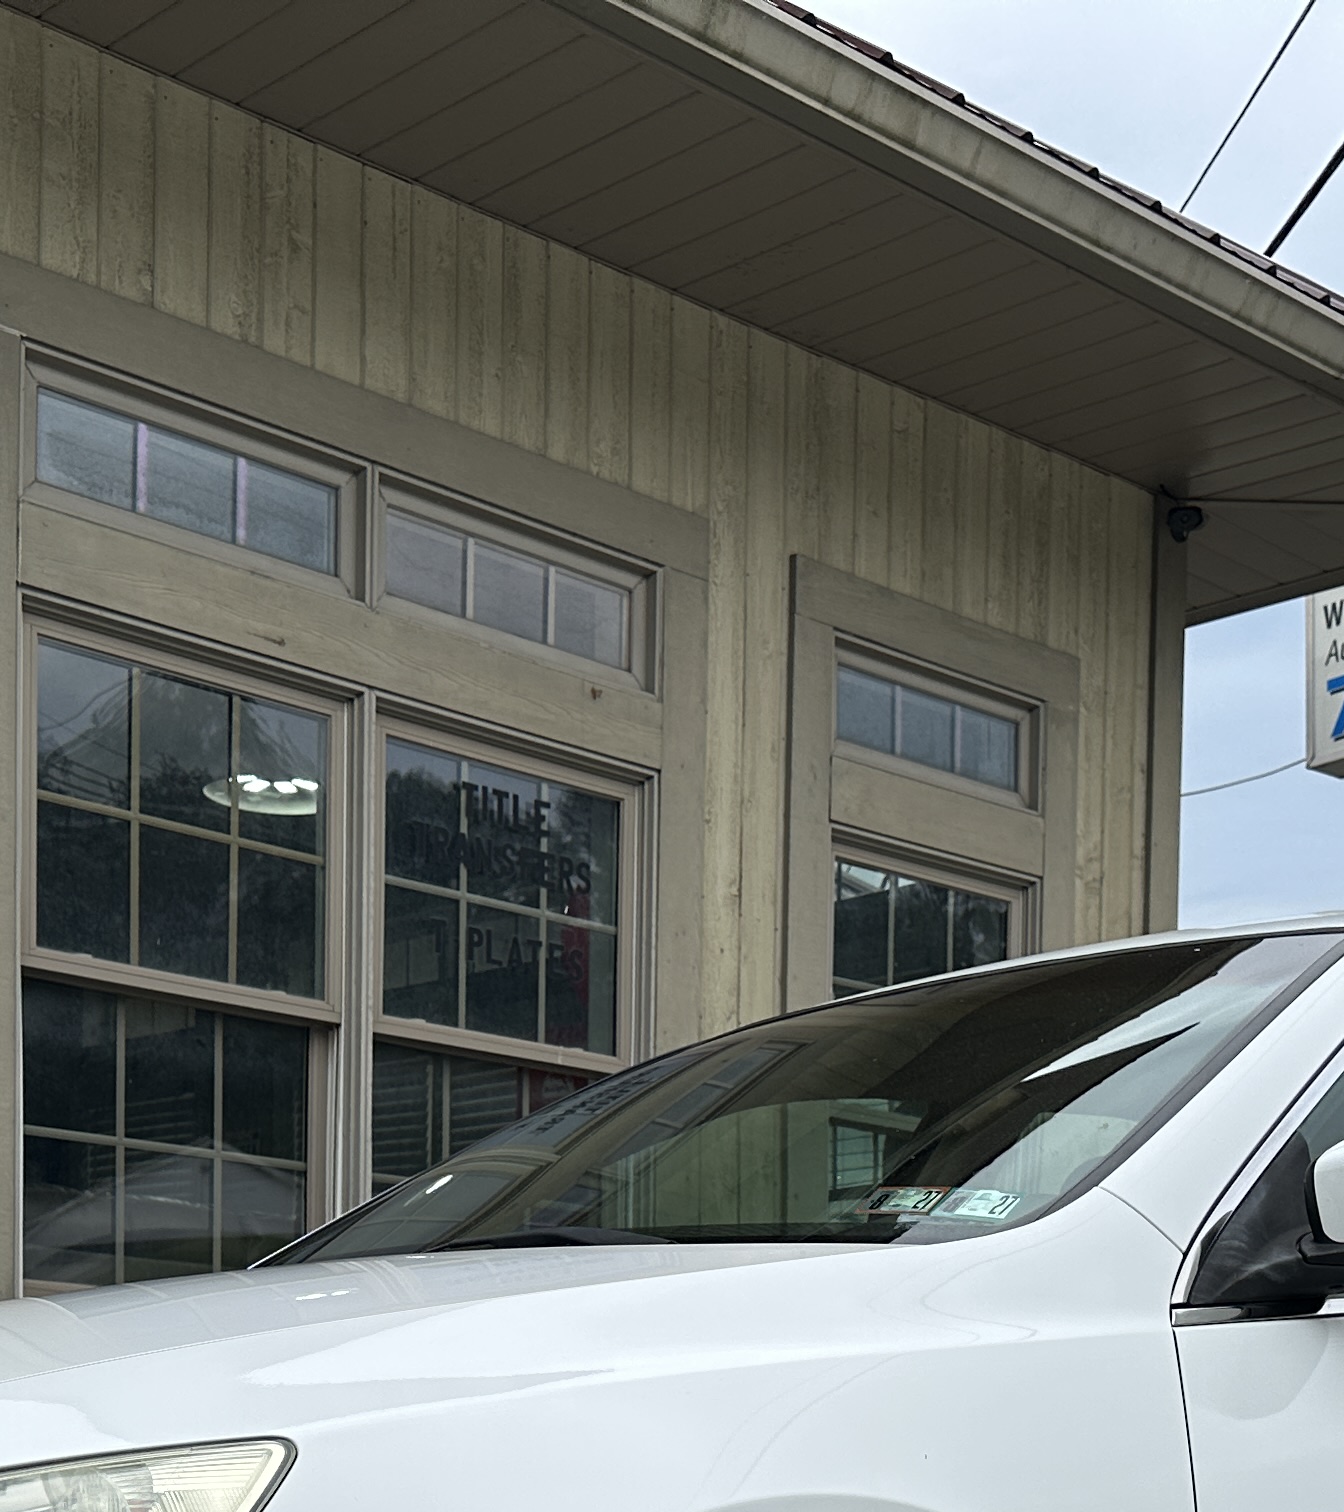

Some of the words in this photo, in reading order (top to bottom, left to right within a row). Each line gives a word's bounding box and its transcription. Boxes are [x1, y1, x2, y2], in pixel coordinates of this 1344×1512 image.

[459, 781, 551, 837] TITLE
[402, 820, 593, 896] TRANSFERS
[911, 1190, 943, 1211] 27
[987, 1195, 1021, 1216] 27
